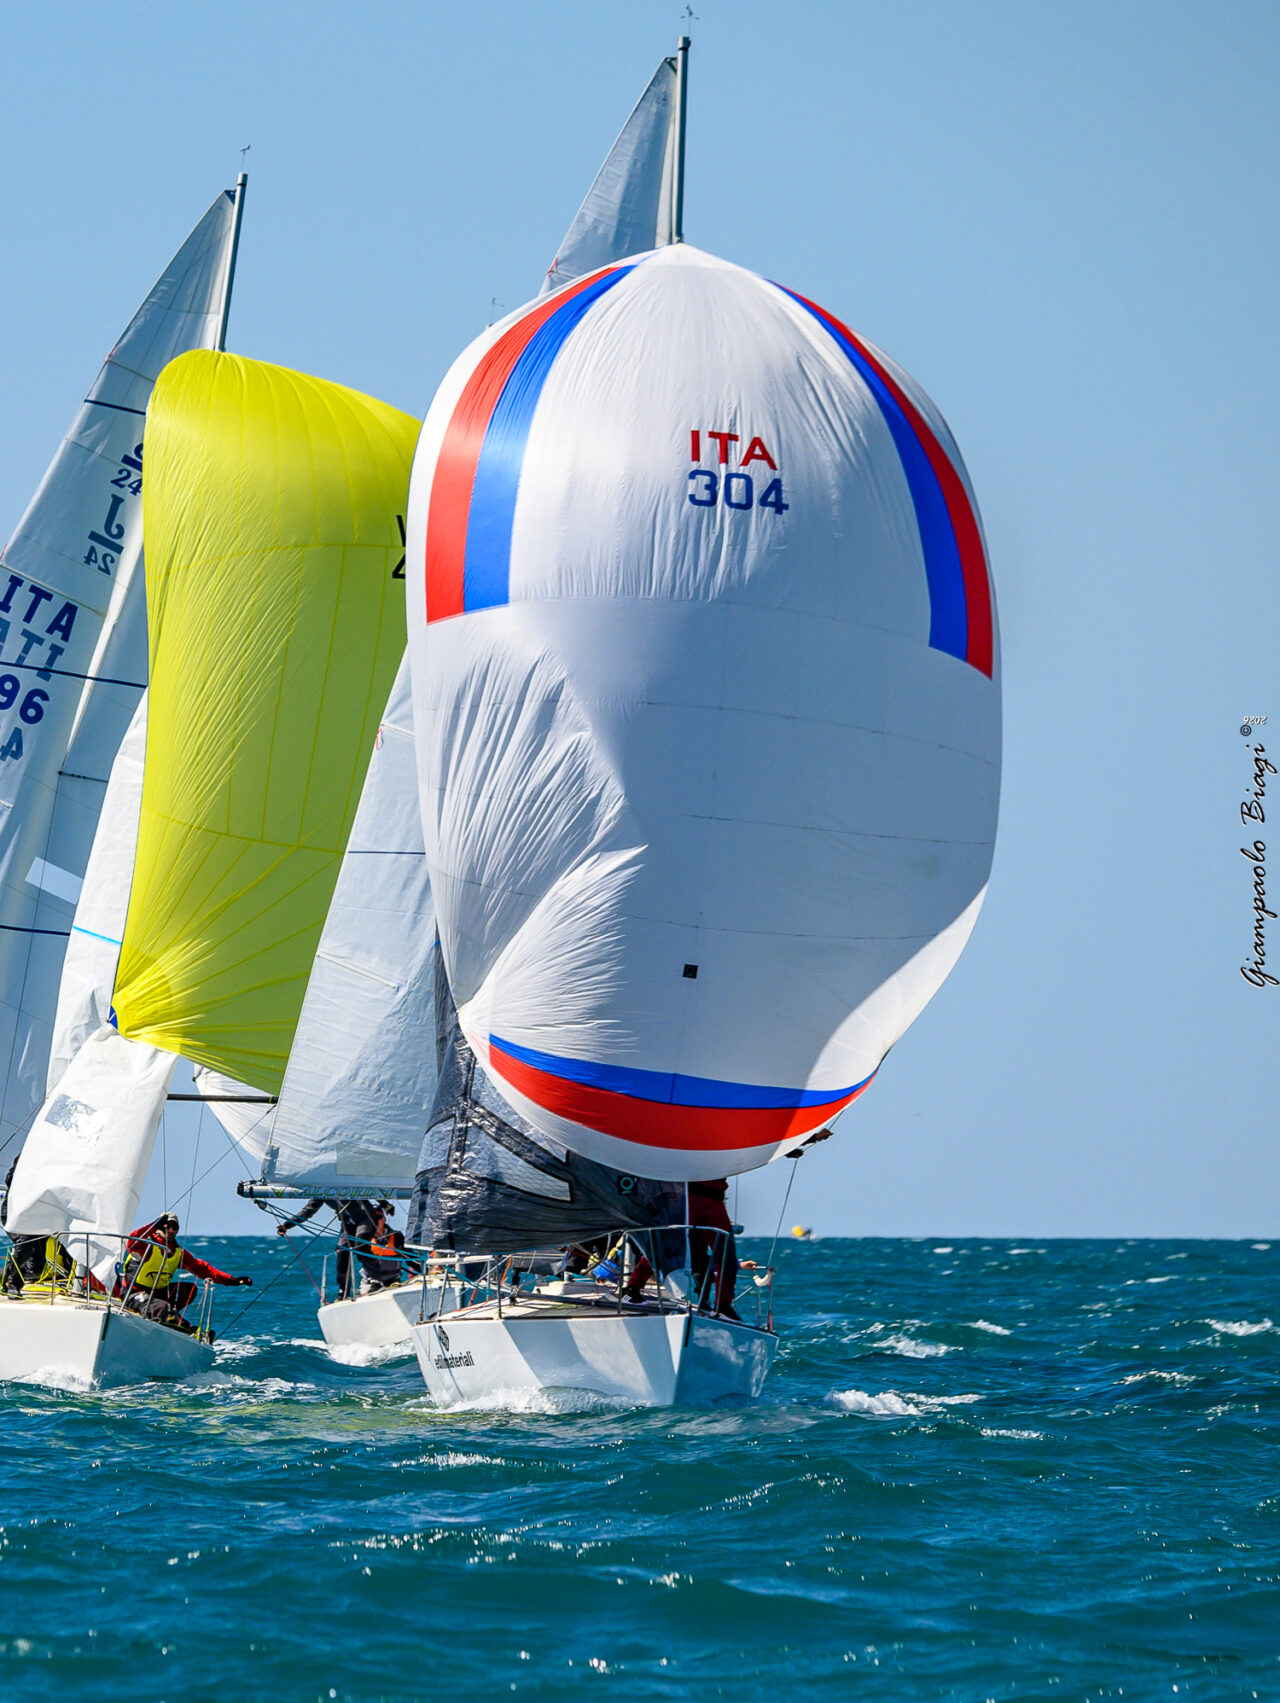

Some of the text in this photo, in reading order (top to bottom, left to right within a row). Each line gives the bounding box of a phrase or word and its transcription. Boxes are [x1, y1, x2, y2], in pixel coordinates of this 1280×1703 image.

[690, 430, 778, 471] ITA
[110, 468, 143, 496] 24
[688, 469, 790, 515] 304
